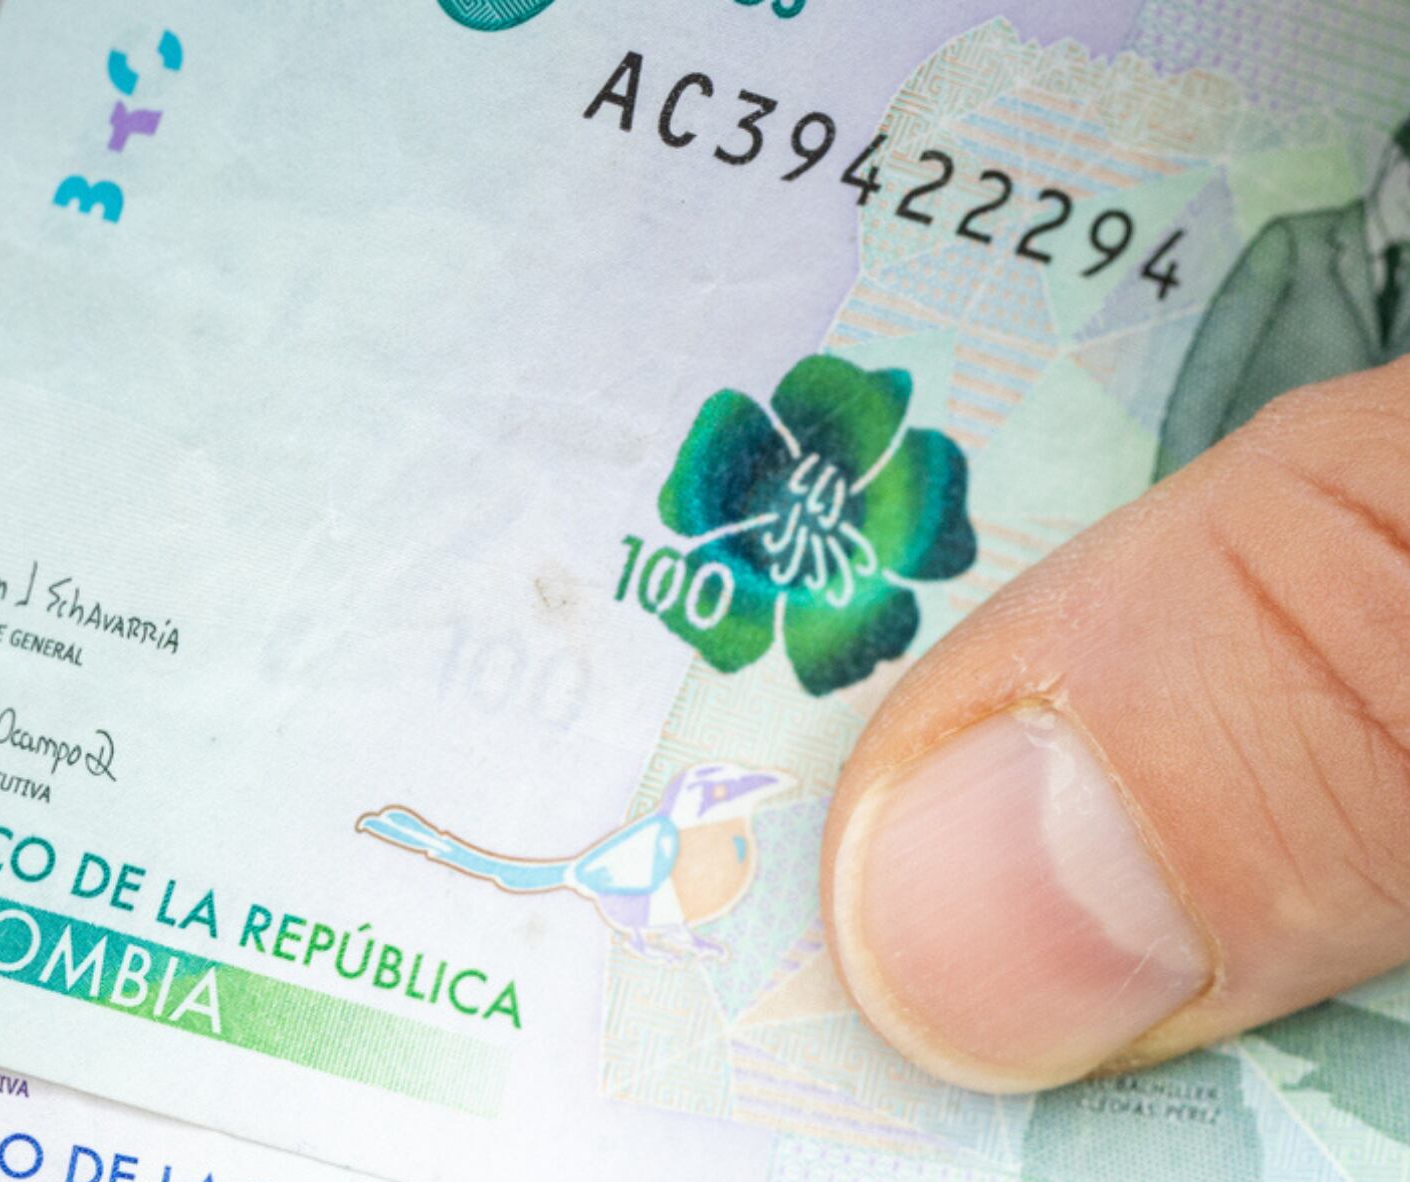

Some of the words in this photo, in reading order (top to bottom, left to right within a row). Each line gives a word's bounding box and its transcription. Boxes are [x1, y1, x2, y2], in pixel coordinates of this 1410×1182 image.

[583, 51, 1187, 300] AC39422294
[10, 629, 83, 667] GENERAL
[614, 534, 736, 631] 100
[72, 850, 147, 915] DE
[158, 879, 219, 940] LA
[241, 908, 524, 1031] REPÚBLICA
